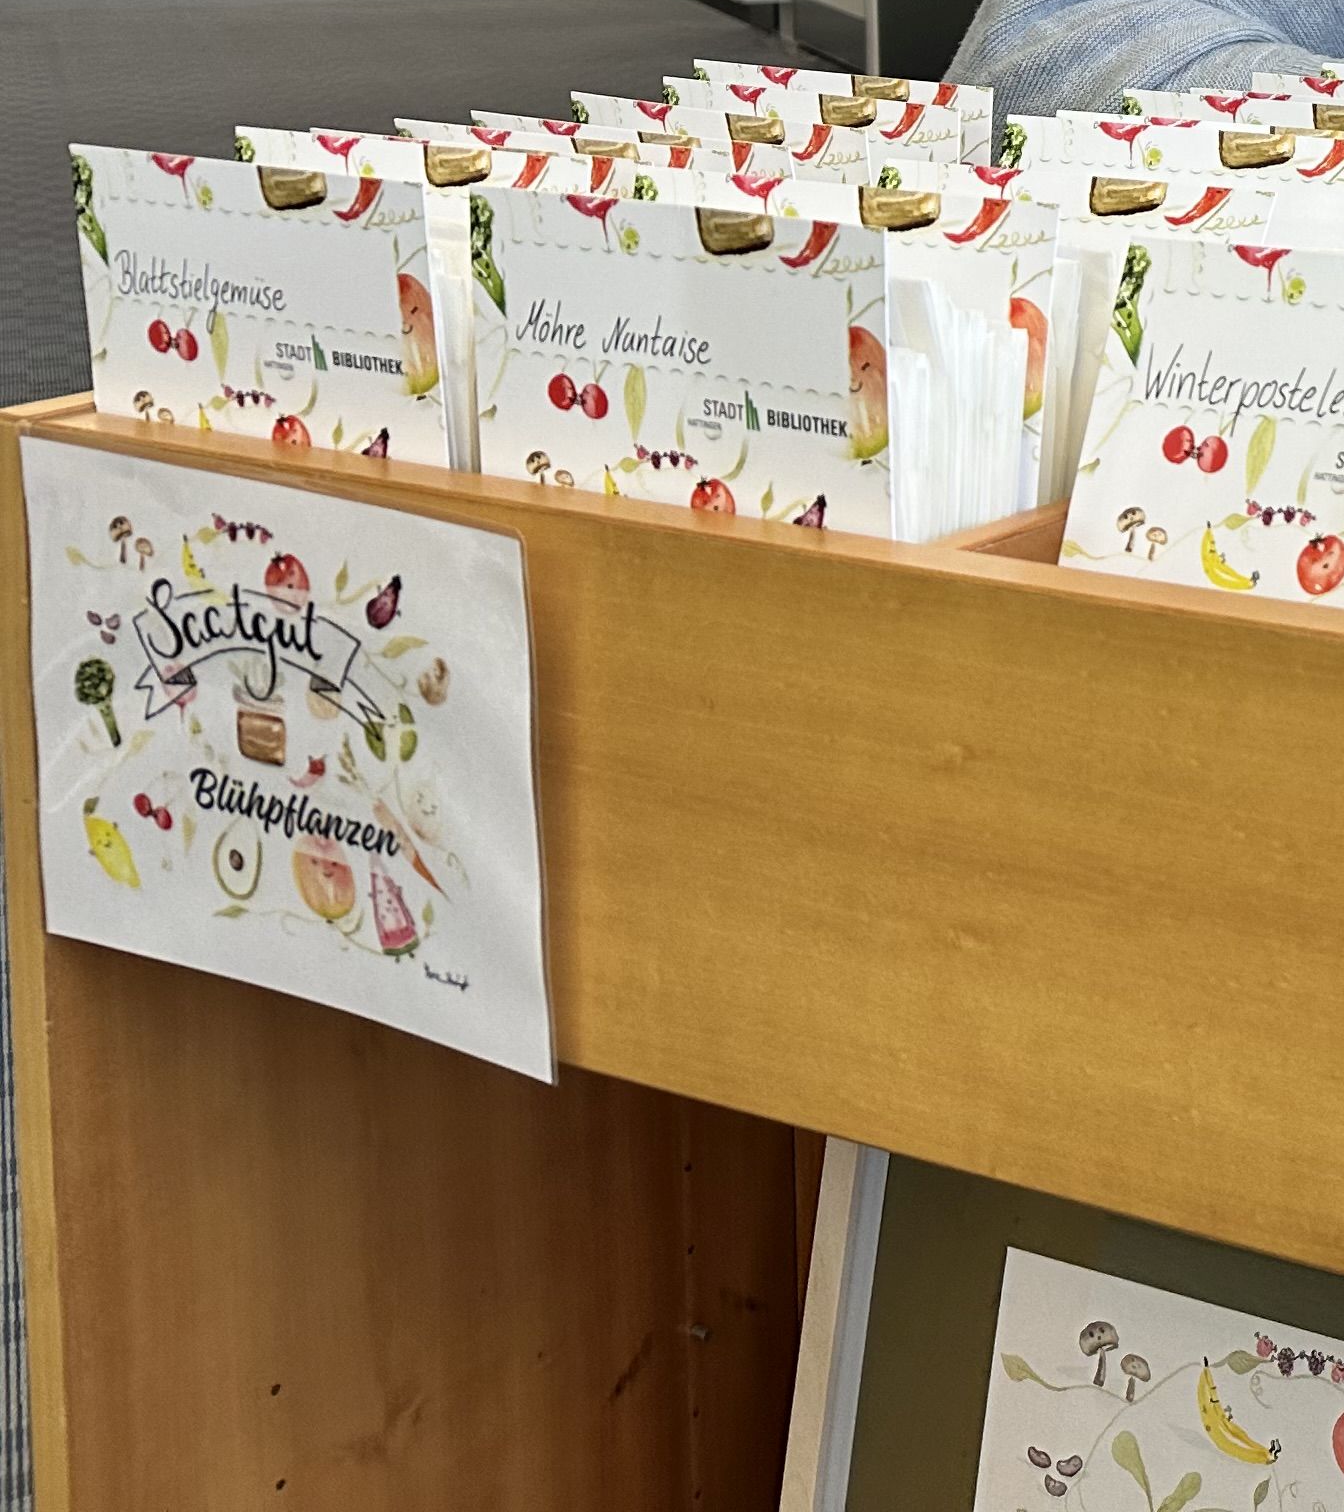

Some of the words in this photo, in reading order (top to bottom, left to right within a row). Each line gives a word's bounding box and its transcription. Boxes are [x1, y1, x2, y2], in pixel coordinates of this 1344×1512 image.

[114, 250, 287, 334] Blattstielgemüse
[276, 342, 312, 362] STADT
[515, 298, 588, 349] Möhre
[602, 314, 713, 366] Nantaise
[703, 398, 743, 421] STADT
[146, 577, 323, 702] Saatgut
[190, 767, 400, 857] Blühpflanzen
